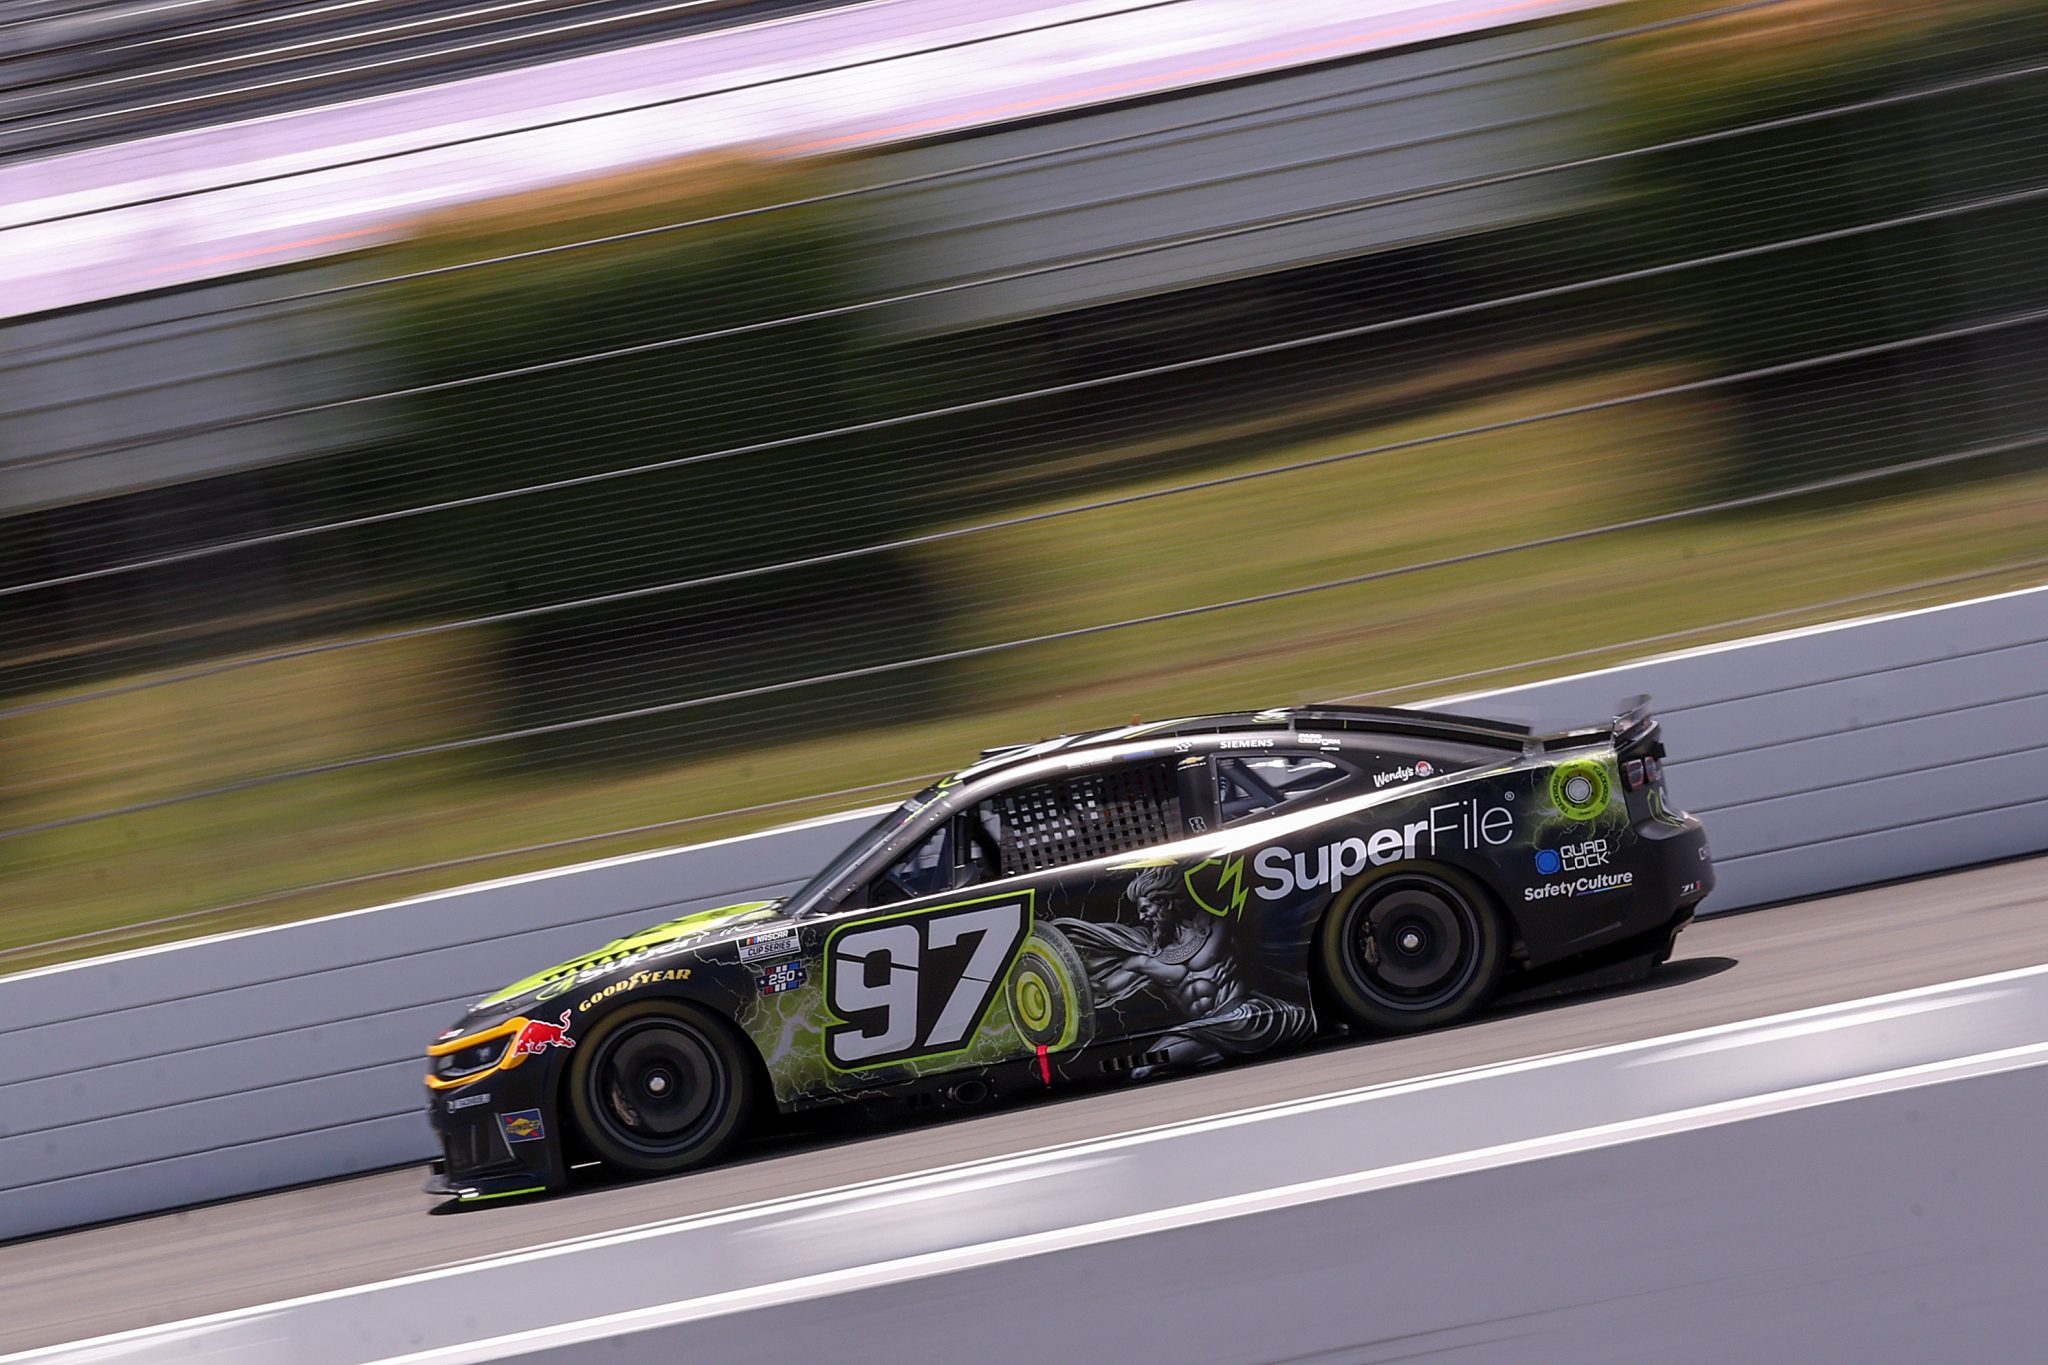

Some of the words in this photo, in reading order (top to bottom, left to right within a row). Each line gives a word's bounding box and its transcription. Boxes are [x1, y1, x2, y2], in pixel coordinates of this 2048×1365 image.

[1220, 739, 1274, 749] SIEMENS
[1373, 766, 1414, 788] Wendy's
[1560, 838, 1607, 859] QUAD
[1562, 852, 1610, 872] LOCK
[1524, 871, 1633, 901] SafetyCulture
[757, 930, 789, 943] NASCAR
[747, 946, 764, 956] CUP
[764, 940, 791, 953] SERIES
[768, 970, 795, 985] 250
[834, 904, 1021, 1061] 97
[578, 968, 692, 1012] GOODYEAR
